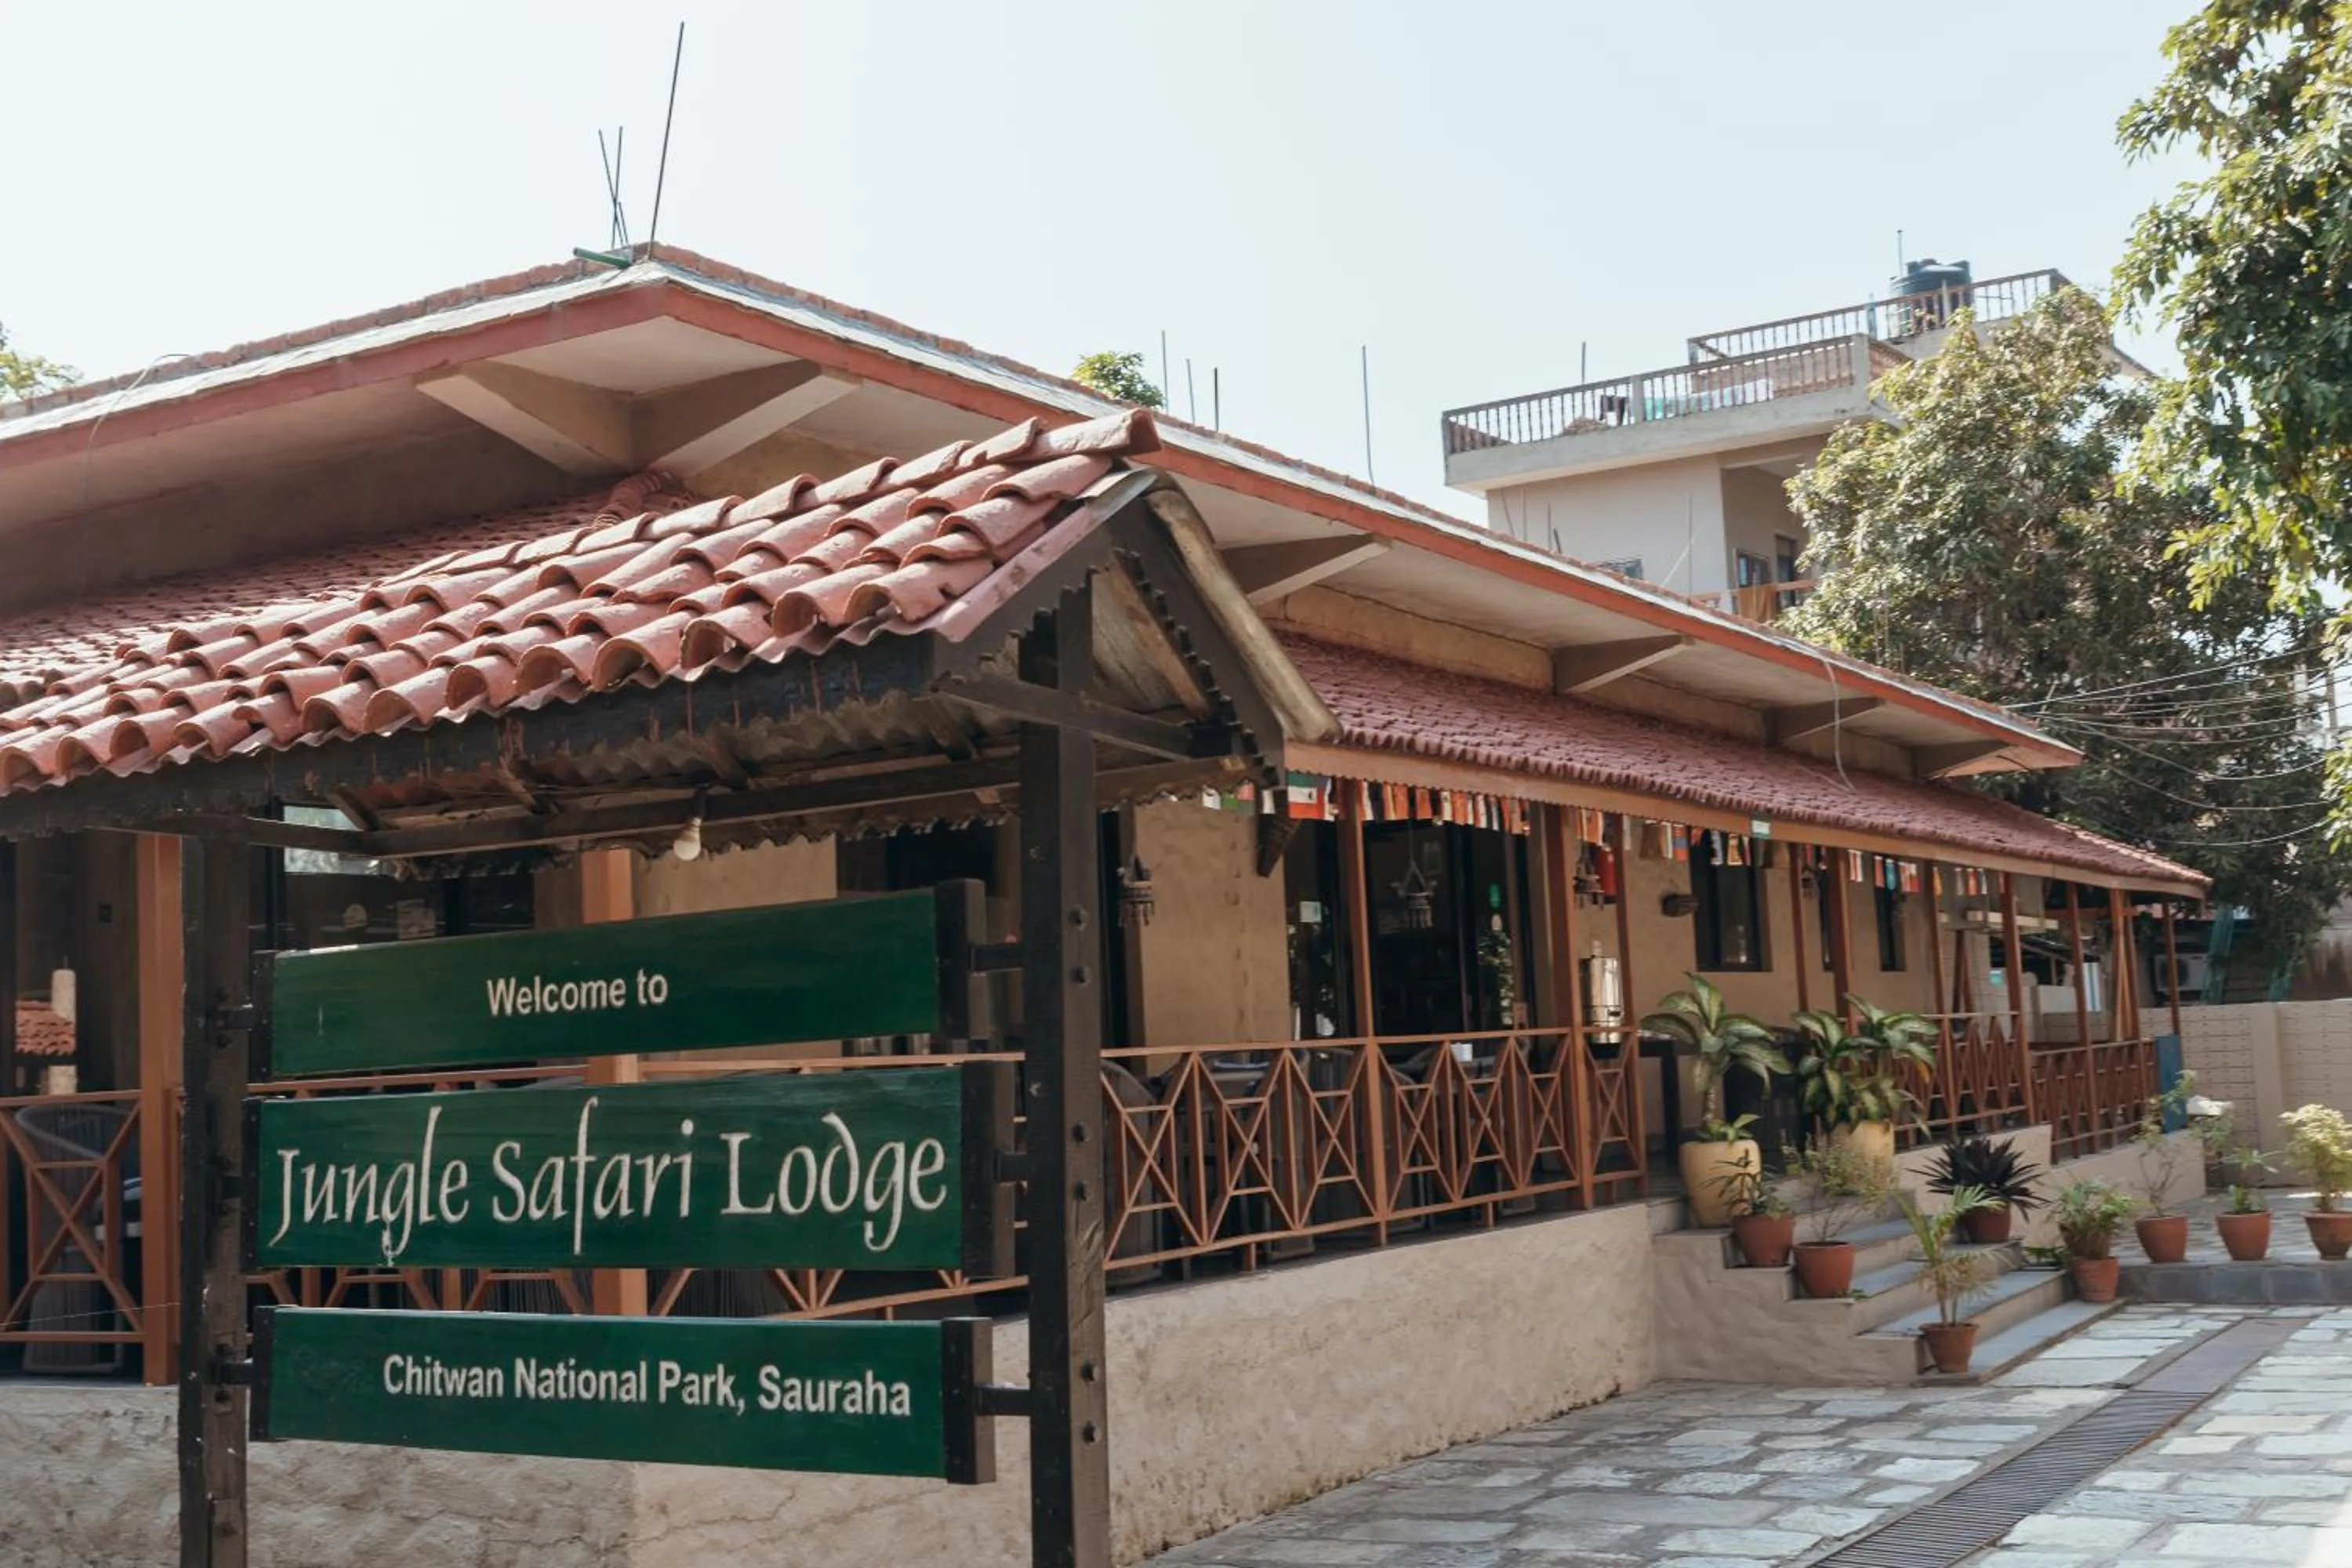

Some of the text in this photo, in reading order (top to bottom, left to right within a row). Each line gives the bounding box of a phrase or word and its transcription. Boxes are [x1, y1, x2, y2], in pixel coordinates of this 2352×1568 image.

[487, 969, 668, 1016] Welcome to
[269, 1097, 946, 1258] Jungle Safari Lodge
[383, 1354, 910, 1416] Chitwan National Park, Sauraha
